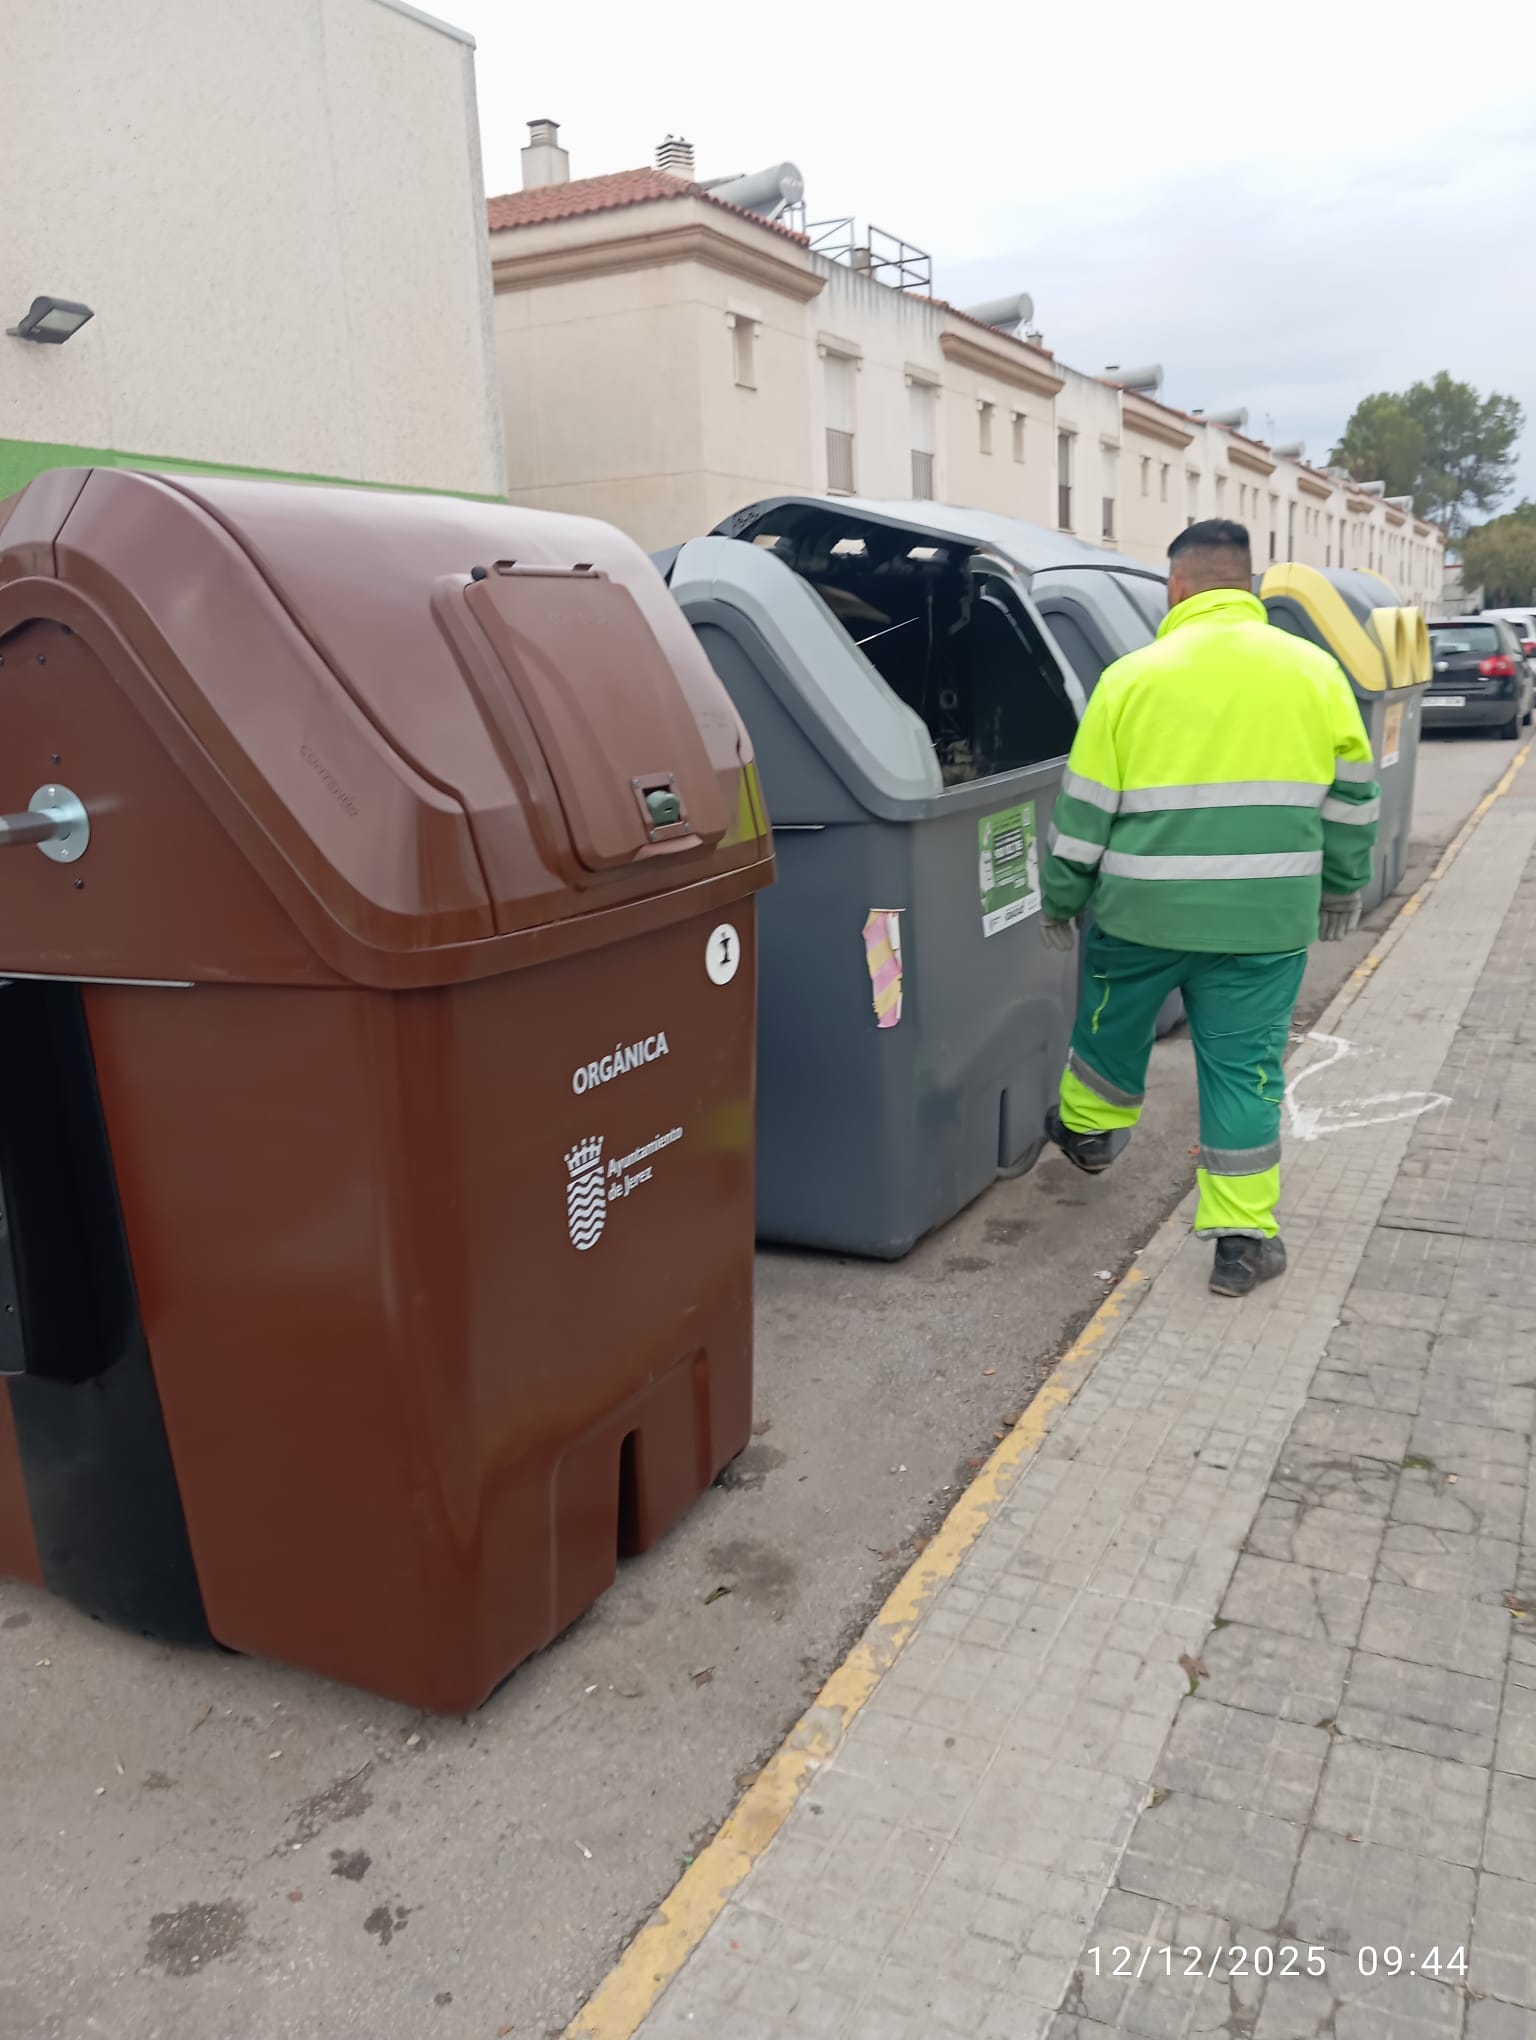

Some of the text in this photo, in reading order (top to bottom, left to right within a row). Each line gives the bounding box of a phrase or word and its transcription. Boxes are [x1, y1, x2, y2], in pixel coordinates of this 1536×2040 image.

[572, 1031, 669, 1095] ORGÁNICA
[607, 1126, 683, 1178] Ayuntamiento
[608, 1166, 653, 1202] de Jerez
